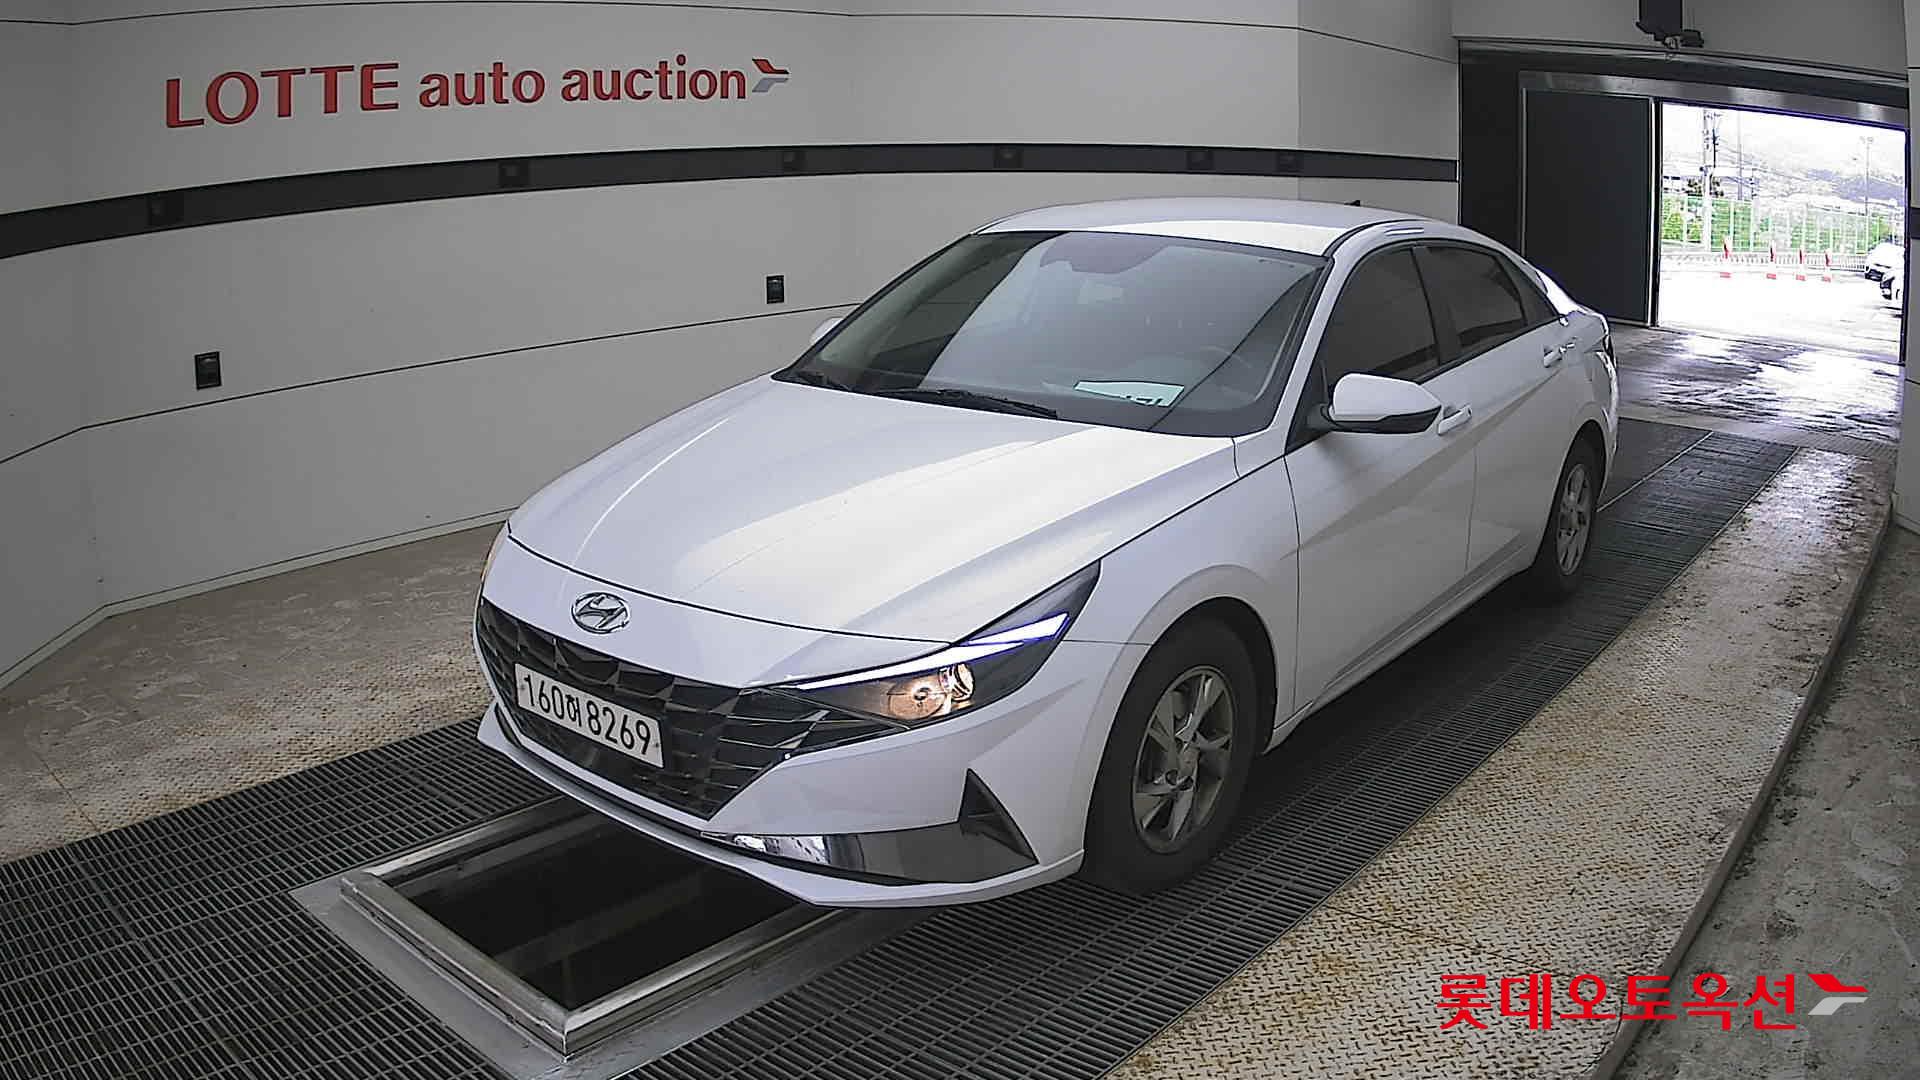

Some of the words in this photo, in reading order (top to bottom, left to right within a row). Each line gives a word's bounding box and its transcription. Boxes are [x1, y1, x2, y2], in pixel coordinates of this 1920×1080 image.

[165, 62, 399, 129] LOTTE
[419, 62, 545, 108] auto
[561, 54, 747, 101] auction
